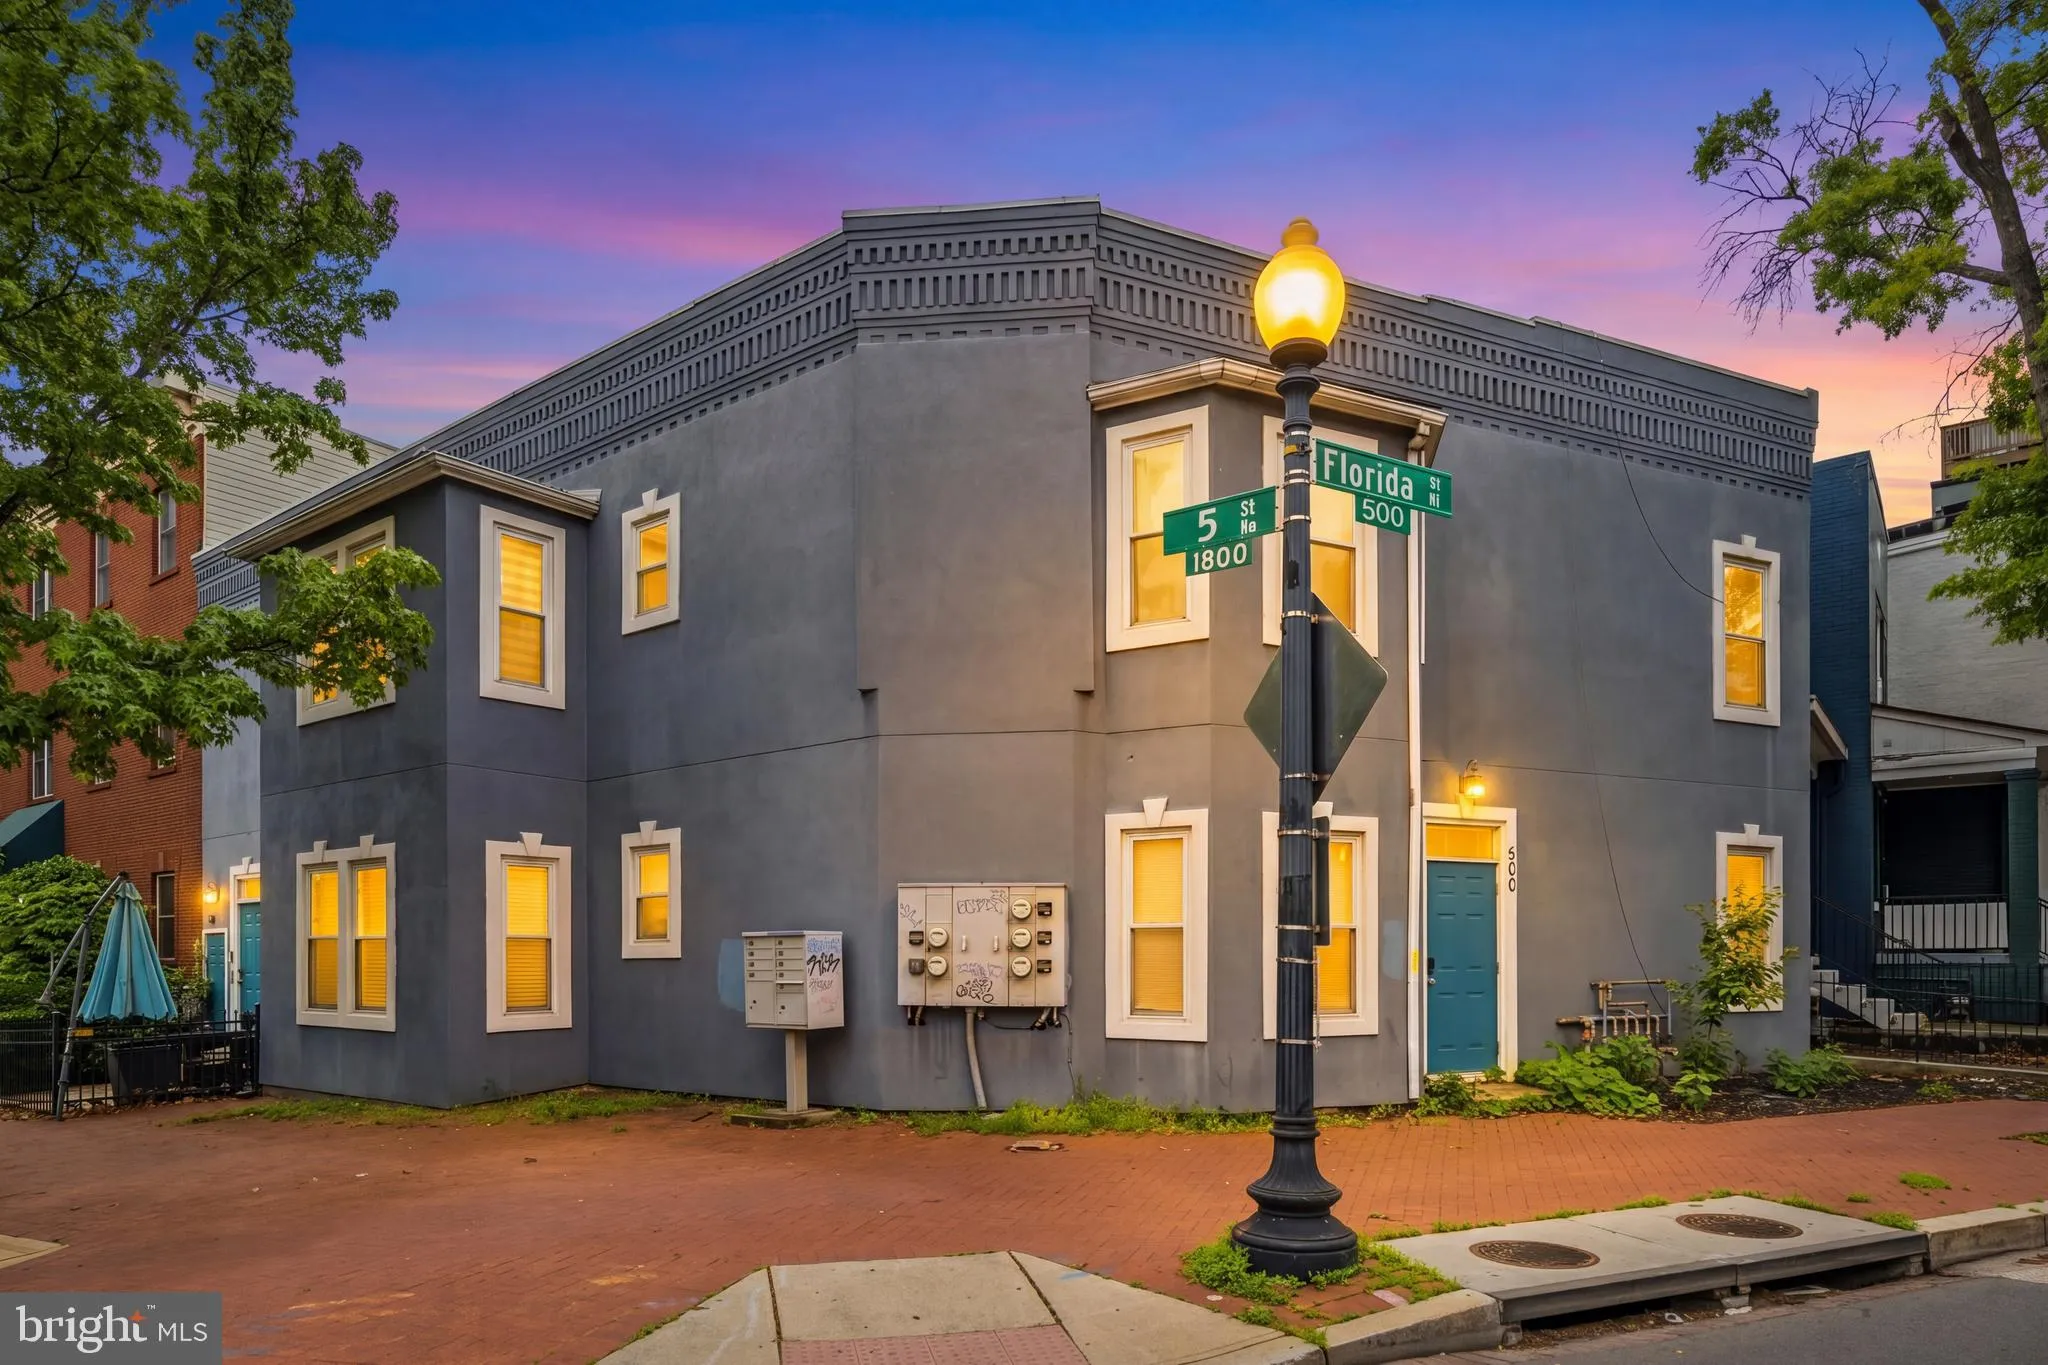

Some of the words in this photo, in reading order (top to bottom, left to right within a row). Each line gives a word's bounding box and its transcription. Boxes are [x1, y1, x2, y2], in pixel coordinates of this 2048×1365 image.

[1324, 447, 1413, 501] Florida
[1429, 476, 1440, 491] St
[1198, 507, 1217, 543] 5
[1240, 498, 1256, 517] St
[1362, 498, 1404, 528] 500
[1193, 543, 1247, 573] 1800
[1508, 846, 1516, 892] 500
